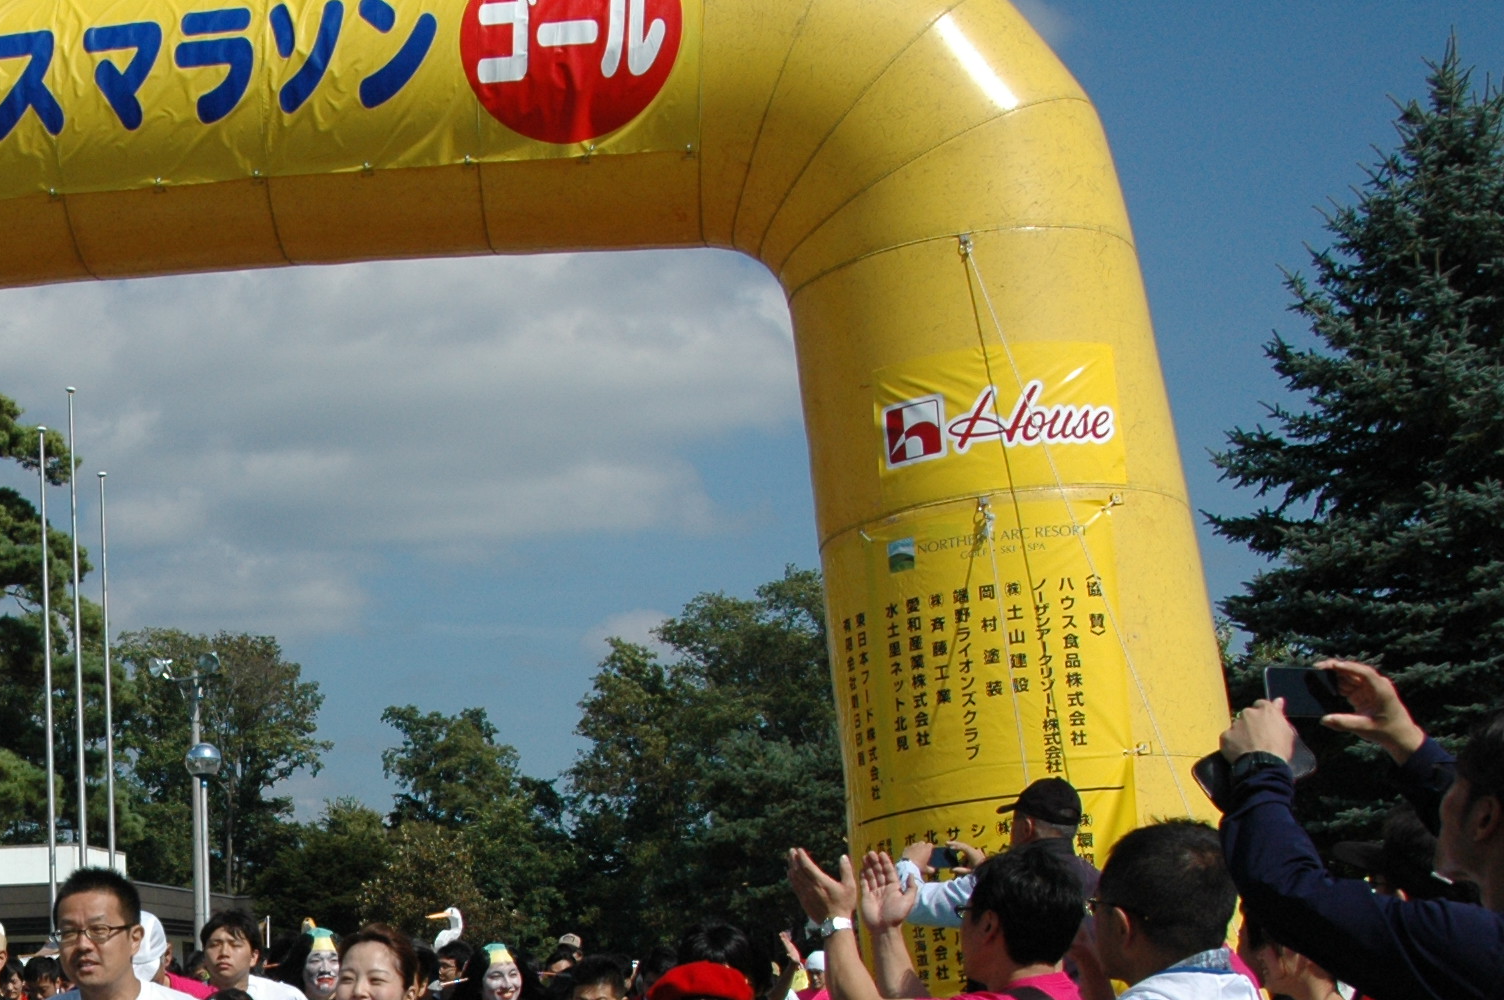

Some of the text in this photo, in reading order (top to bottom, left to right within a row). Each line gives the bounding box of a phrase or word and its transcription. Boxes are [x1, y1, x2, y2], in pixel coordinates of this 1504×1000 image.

[477, 0, 666, 83] ゴール
[948, 384, 1110, 450] House
[917, 524, 1087, 554] NORTHEN ARC RESORT
[855, 612, 881, 801] 東日本フード株式会社
[885, 603, 909, 752] 水土里ネット北見
[905, 597, 931, 748] 愛和産業株式会社
[953, 587, 980, 760] 端野ライオンズクラブ
[978, 584, 1003, 697] 岡村塗装
[1033, 578, 1064, 774] ノーザンアークリゾート株式会社
[1059, 577, 1087, 747] ハウス食品株式会社
